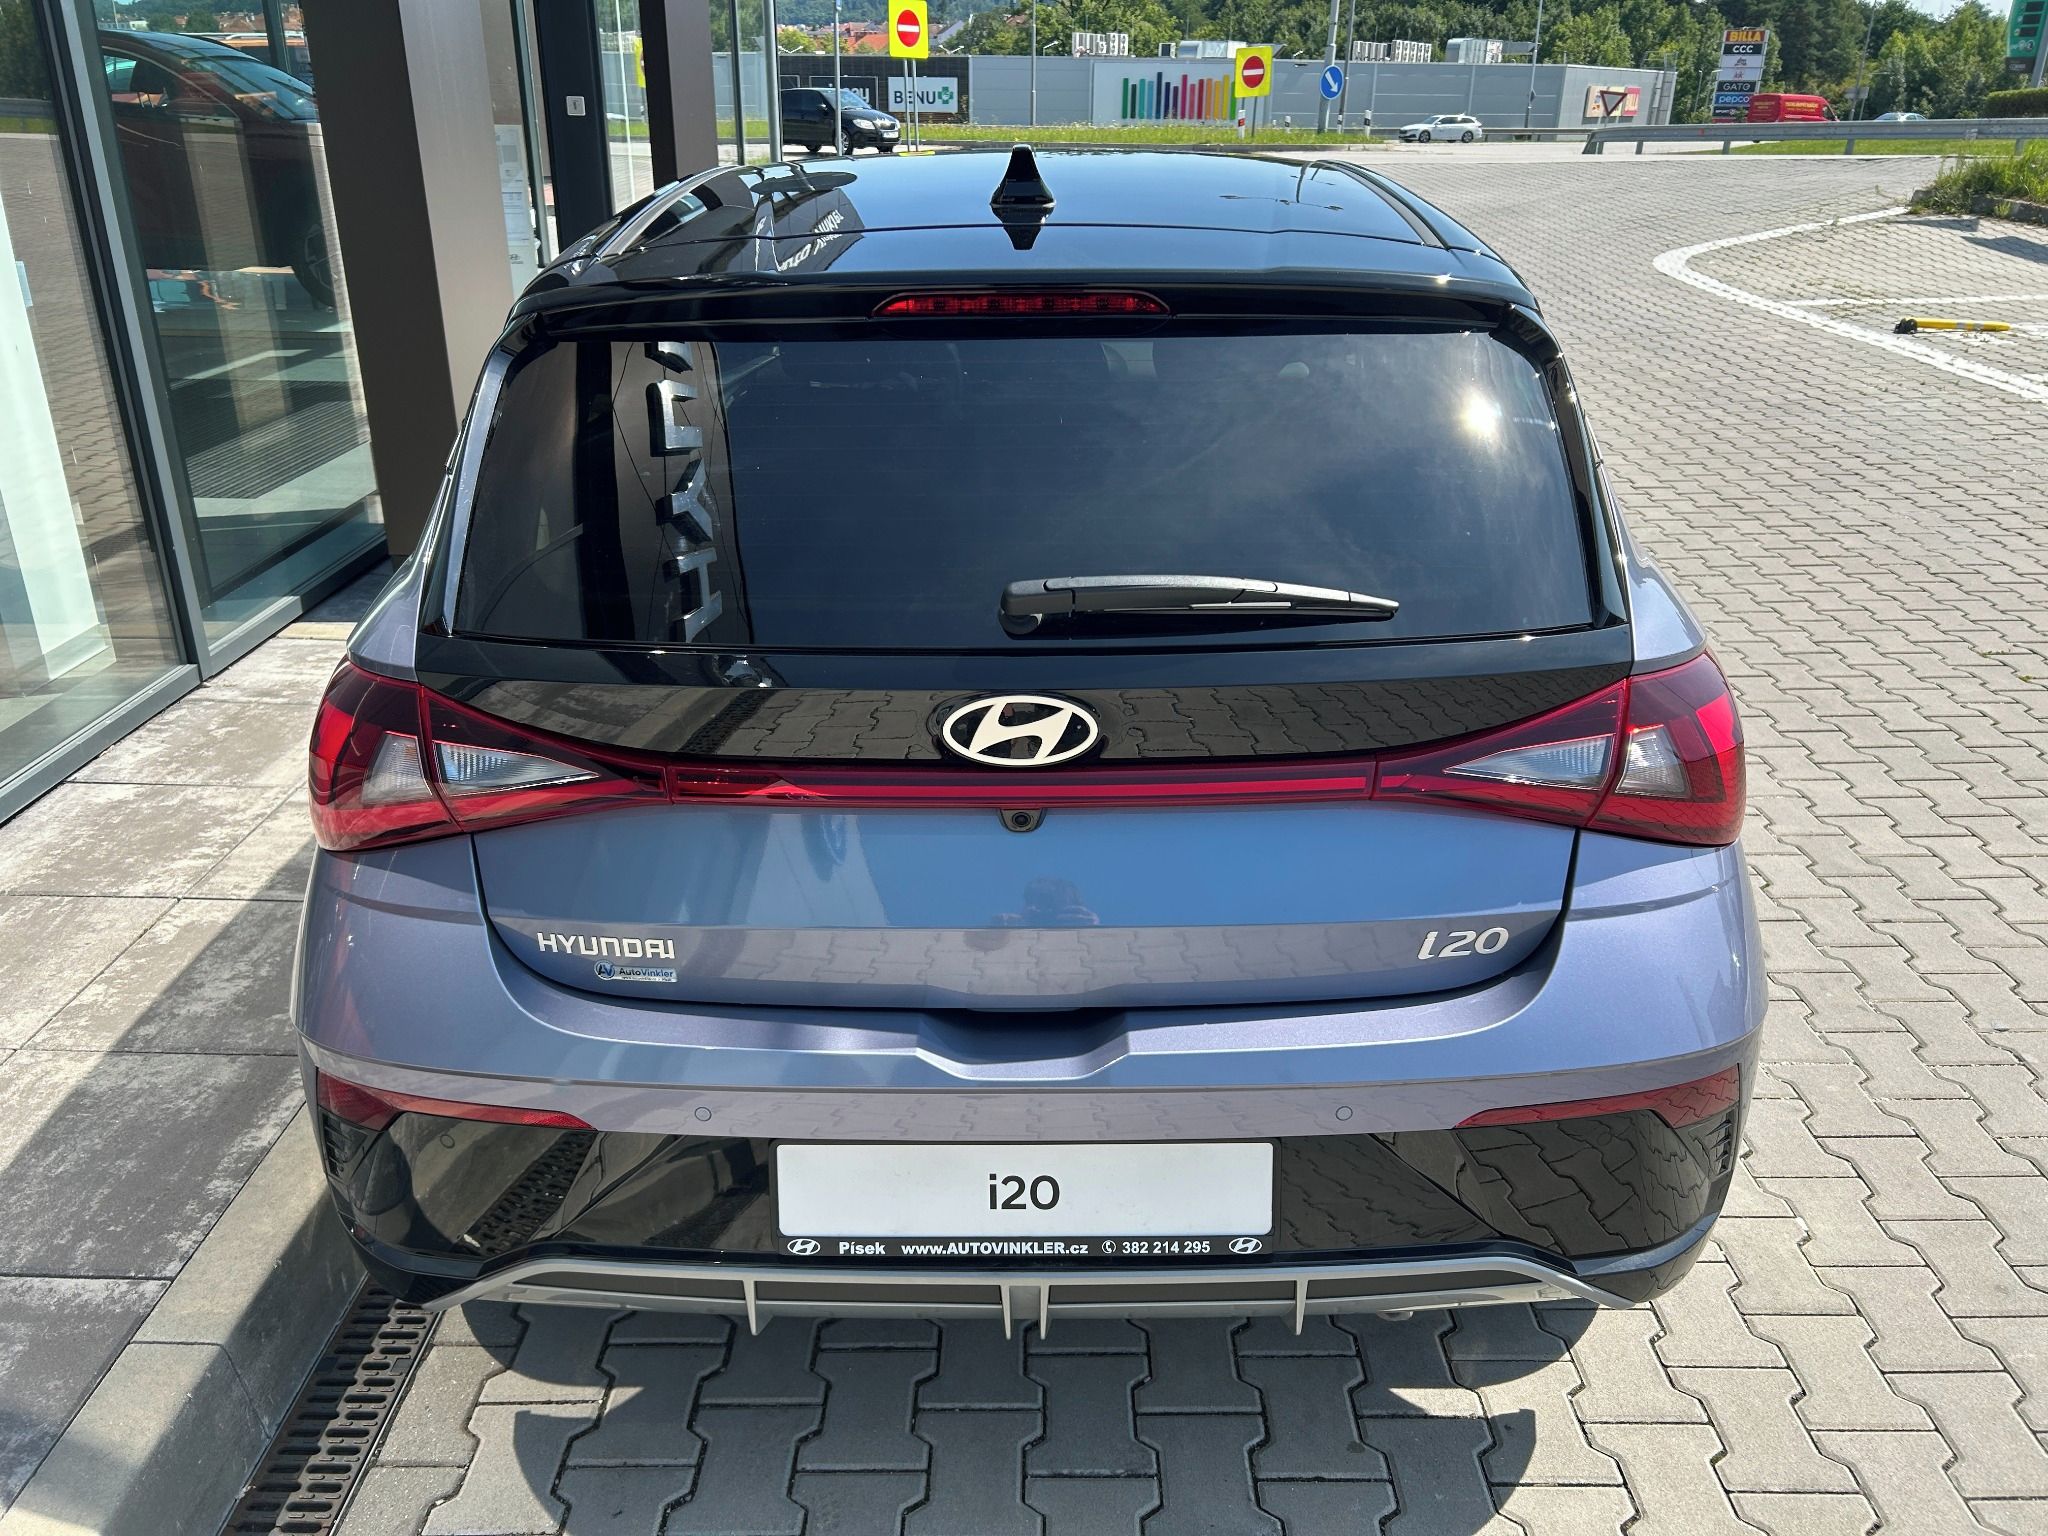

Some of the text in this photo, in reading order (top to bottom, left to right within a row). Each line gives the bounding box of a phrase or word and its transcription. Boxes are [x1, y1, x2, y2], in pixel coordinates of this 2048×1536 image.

[1729, 31, 1761, 42] BILLA
[1732, 45, 1754, 53] CCC
[894, 91, 936, 104] BENU
[1718, 95, 1751, 104] pepco
[537, 932, 676, 959] HYUNDAI
[1418, 927, 1509, 960] i20
[619, 966, 674, 978] AutoVinkler
[989, 1173, 1060, 1210] i20
[839, 1240, 1211, 1255] Písek www.AUTOVINKLER.cz 382 214 295
